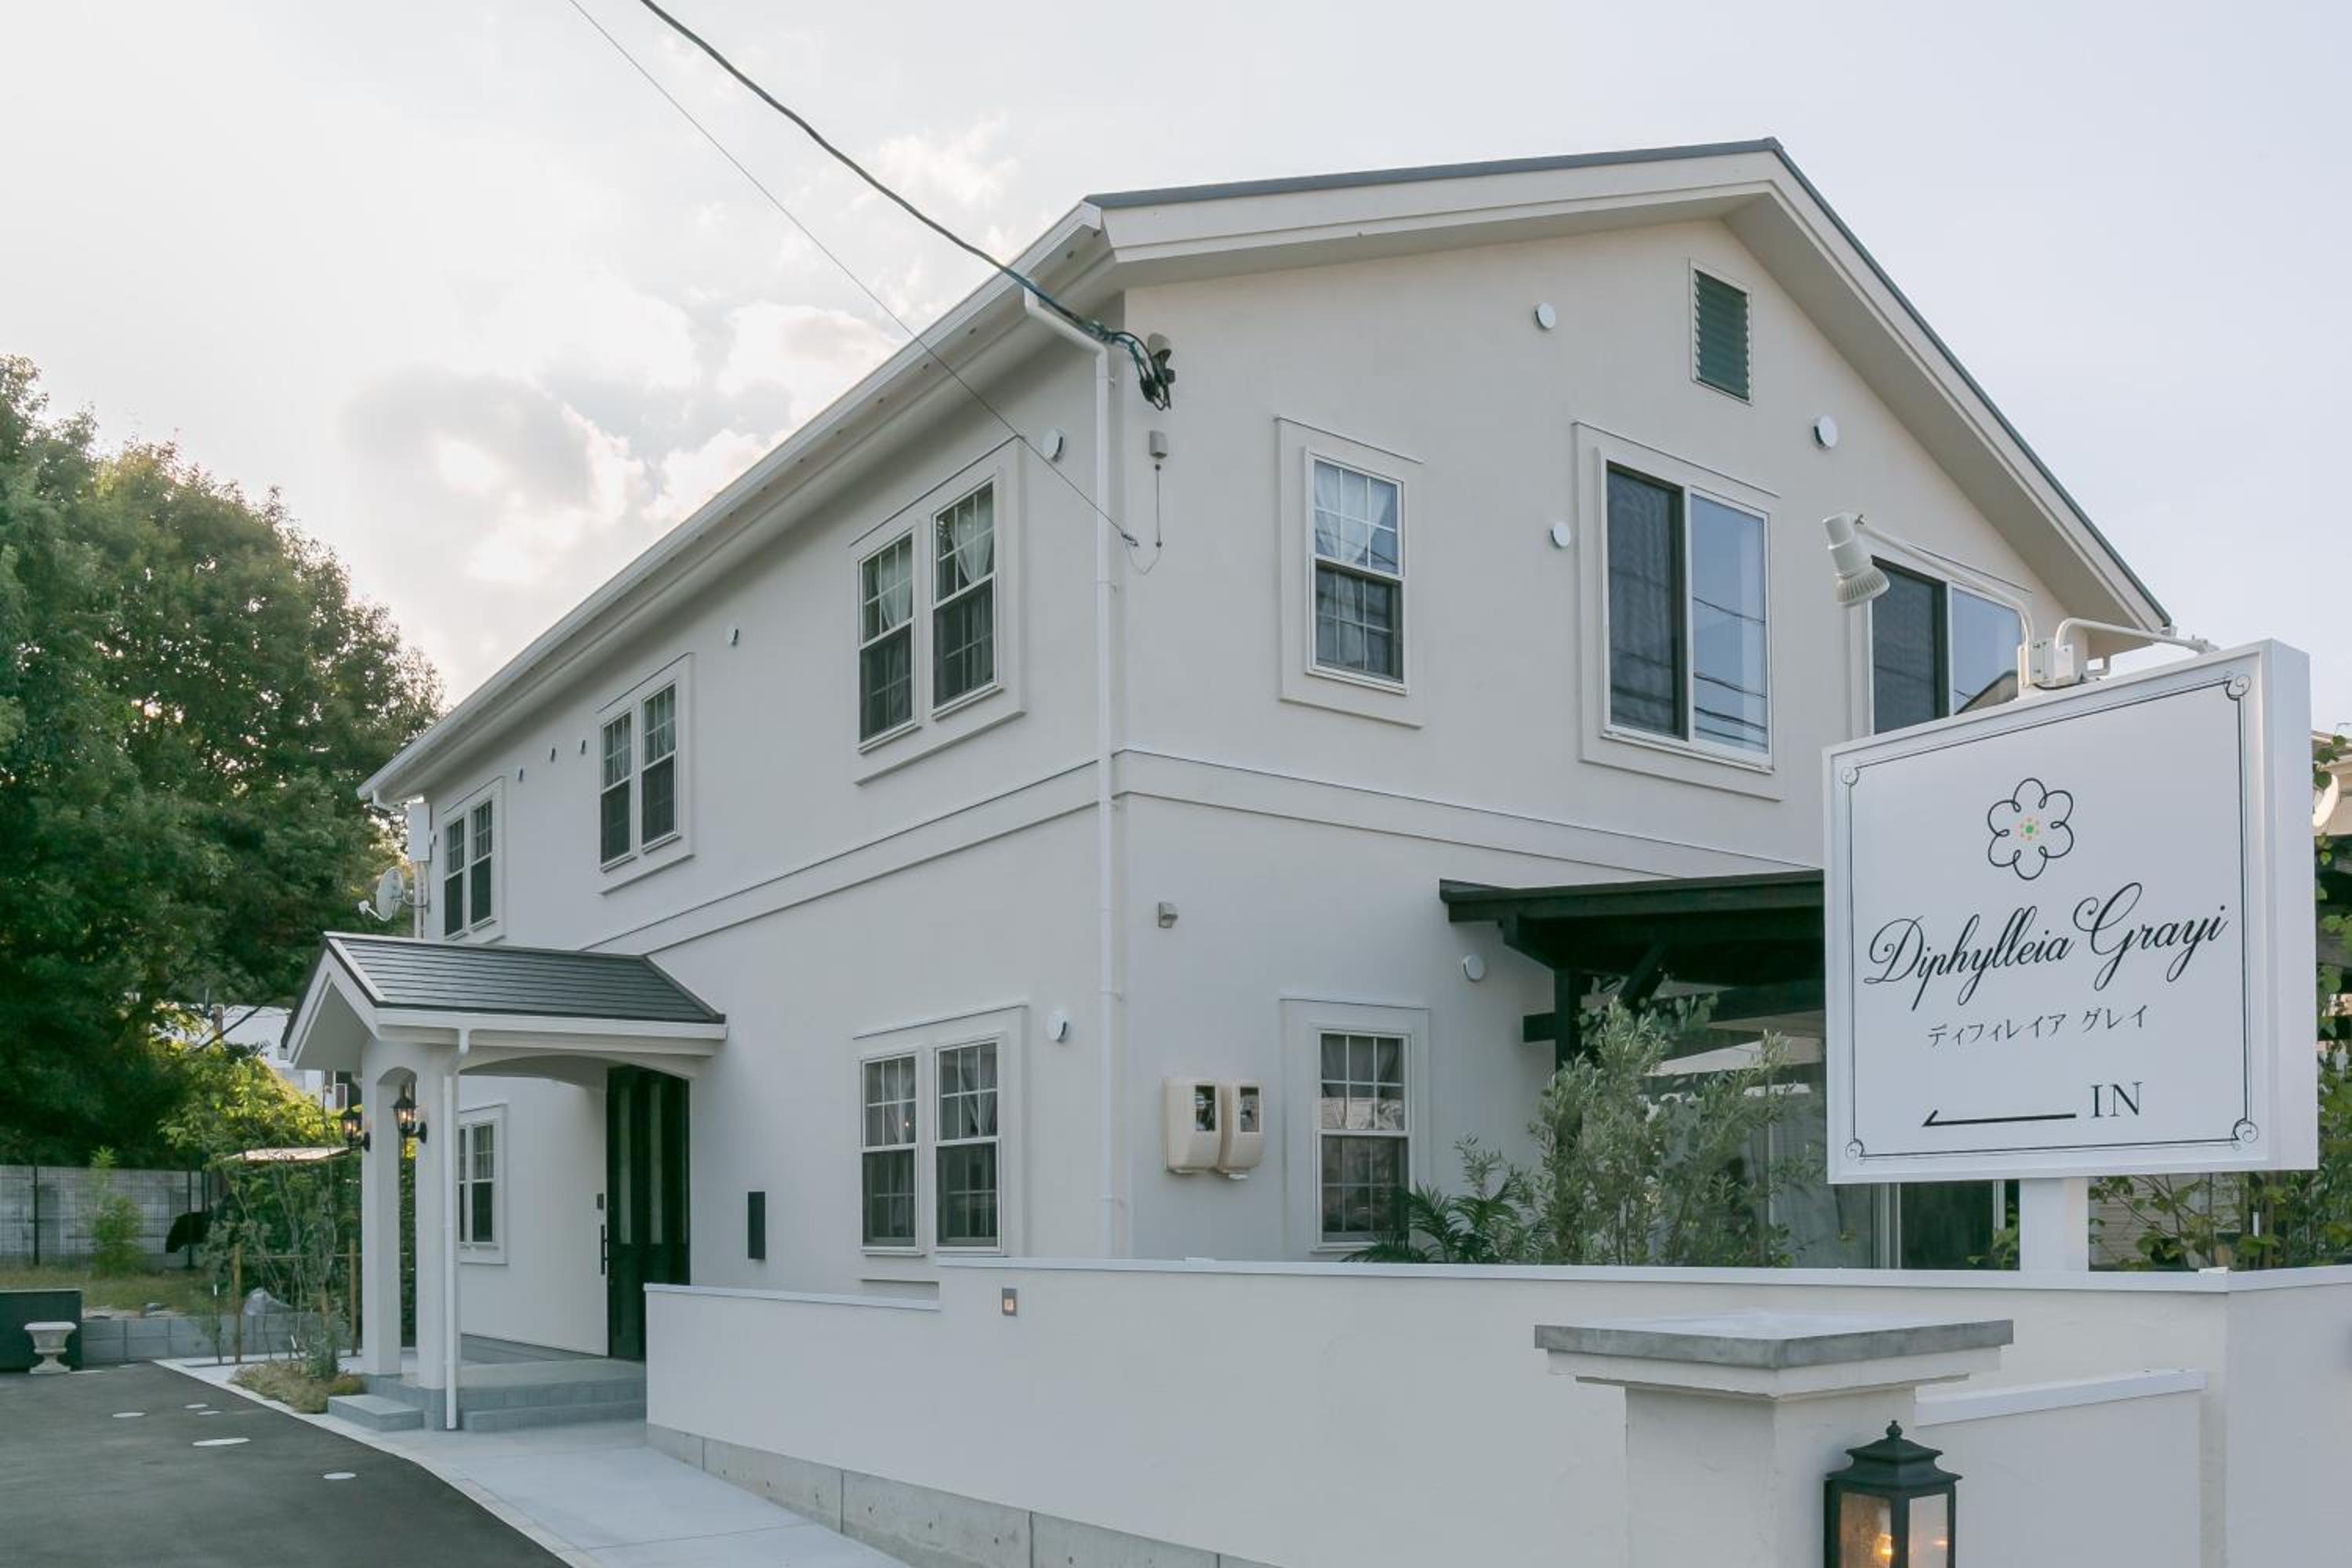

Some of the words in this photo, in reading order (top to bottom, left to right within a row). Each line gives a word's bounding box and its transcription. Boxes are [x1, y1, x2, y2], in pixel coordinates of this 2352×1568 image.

[1863, 906, 2076, 1011] Diphylleia
[2072, 881, 2229, 992] Grayi
[1927, 1013, 2067, 1048] ディフィレイア
[2082, 1004, 2148, 1033] グレイ
[2089, 1081, 2144, 1120] IN
